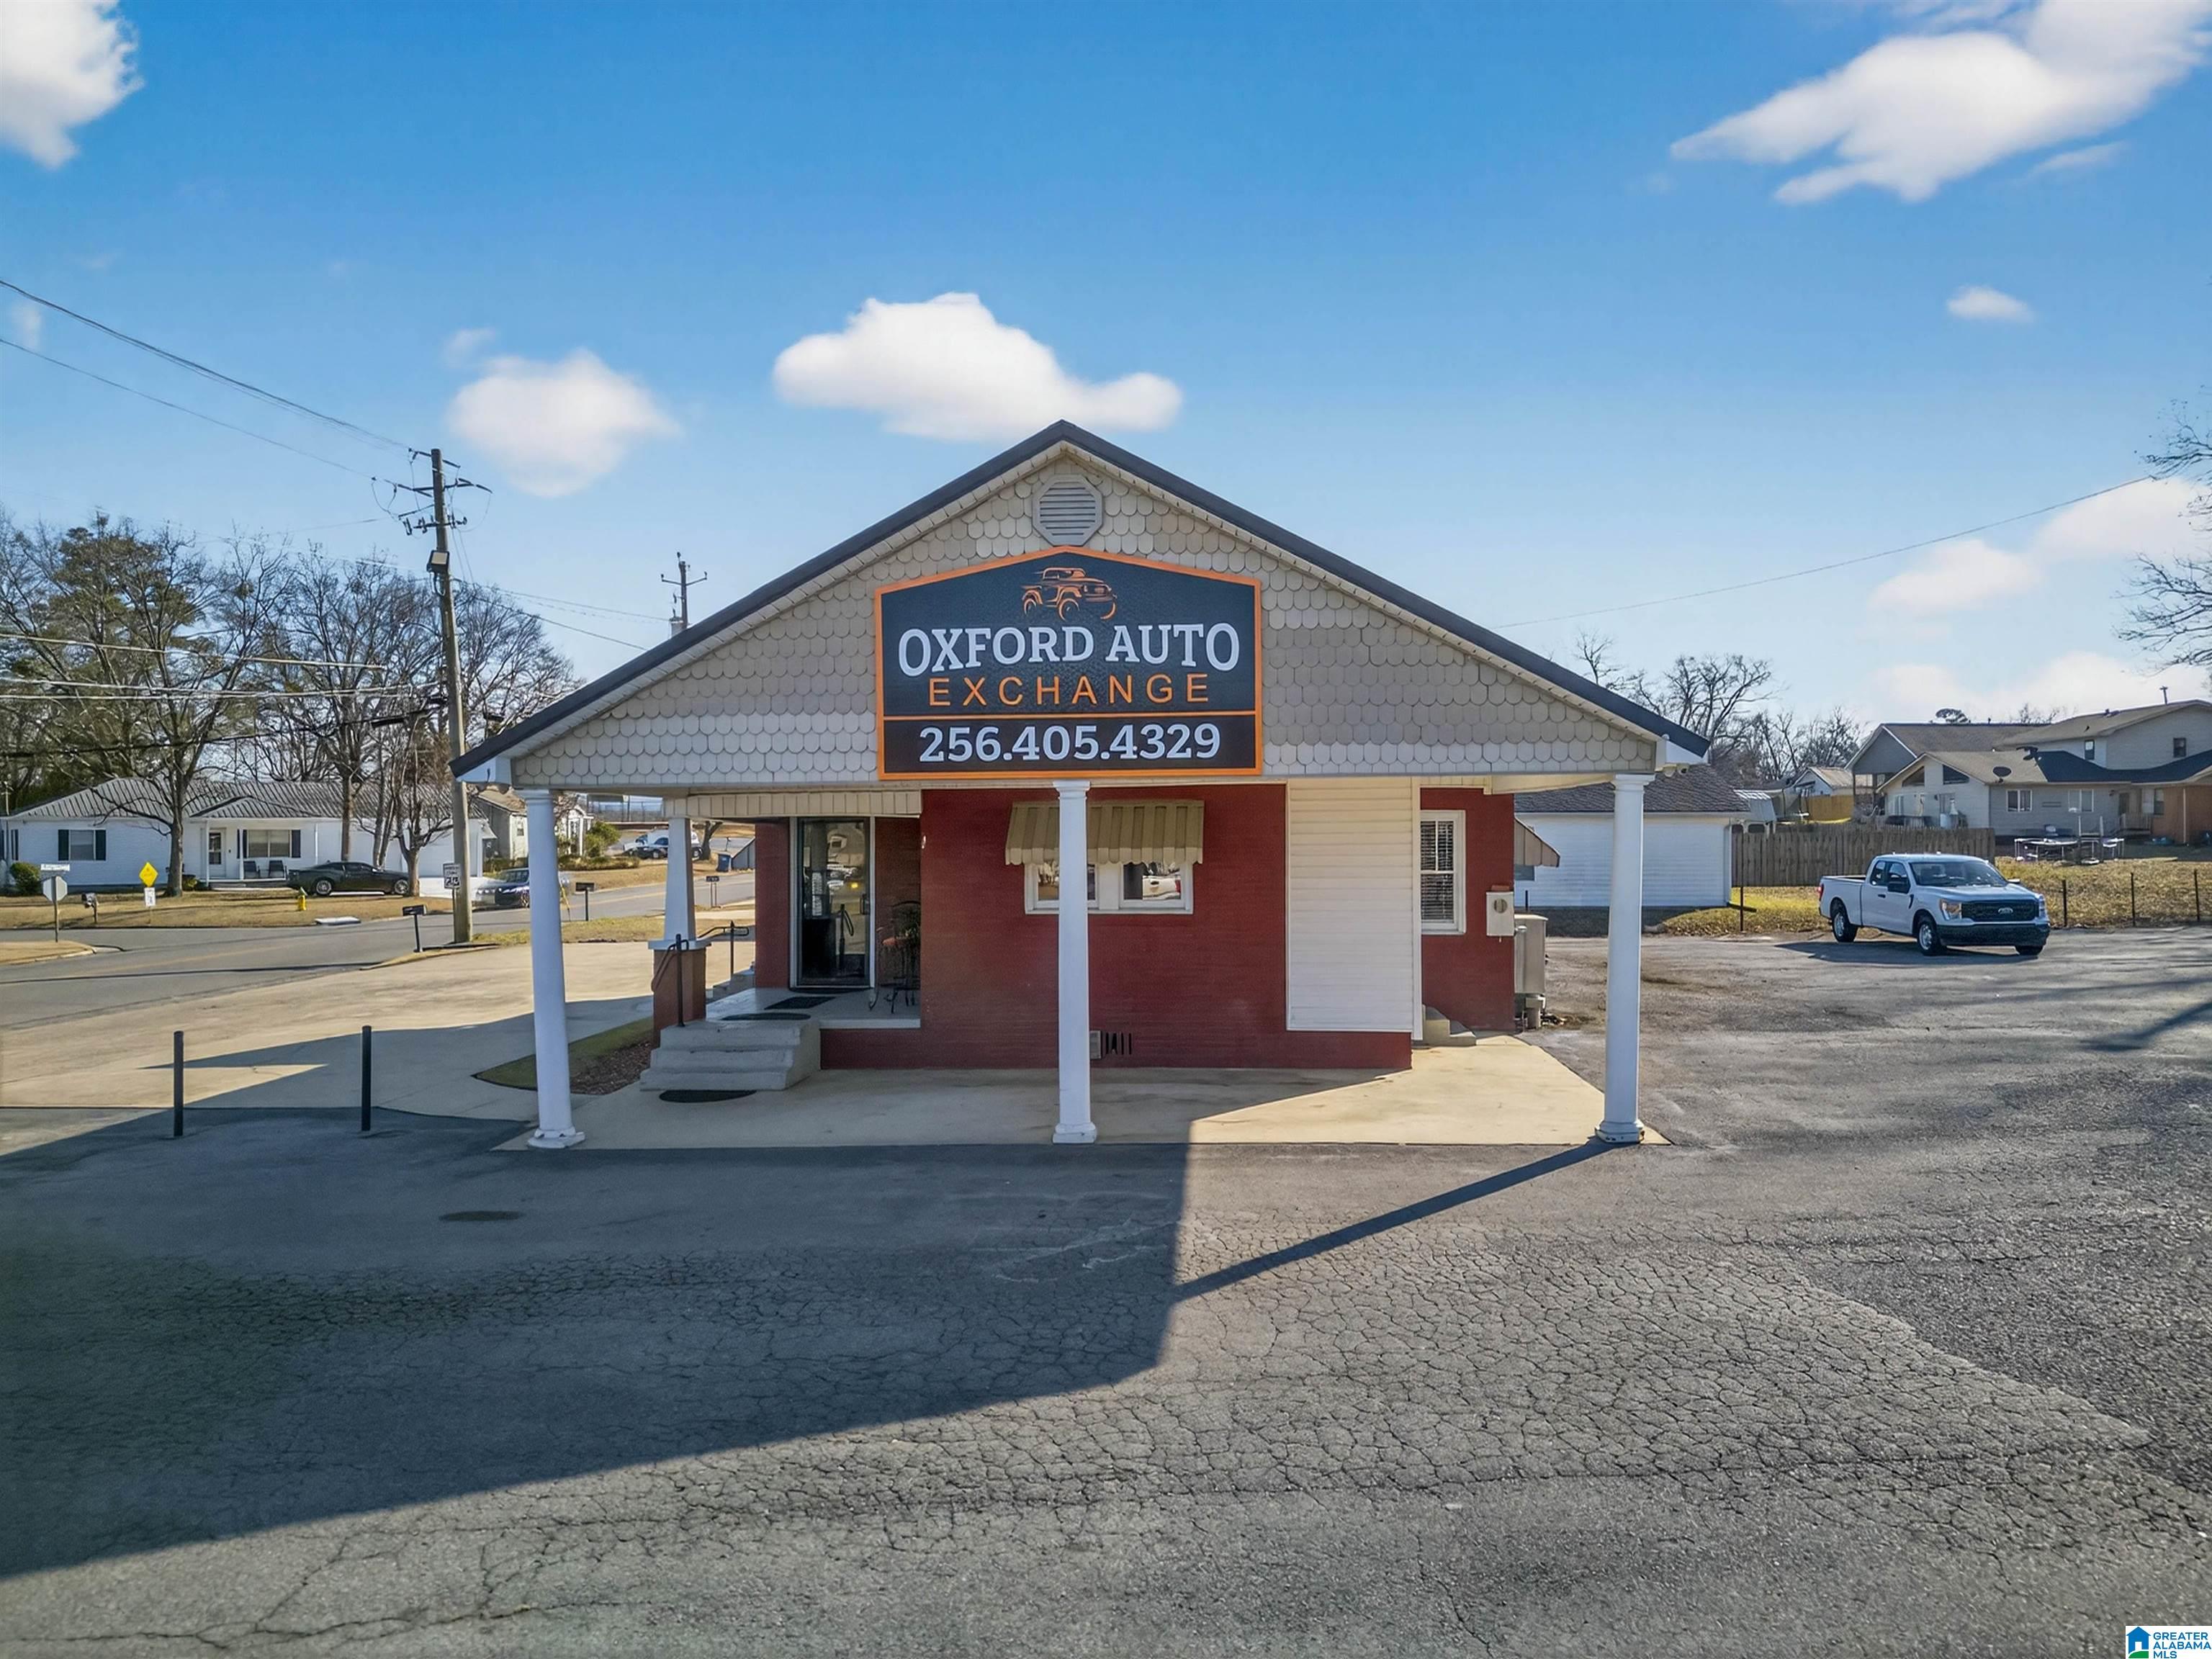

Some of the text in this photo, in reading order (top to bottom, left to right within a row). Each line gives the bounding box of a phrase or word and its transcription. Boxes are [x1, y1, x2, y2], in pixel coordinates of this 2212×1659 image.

[898, 623, 1240, 677] OXFORD AUTO
[928, 673, 1208, 706] EXCHANGE
[919, 723, 1221, 762] 256.405.4329
